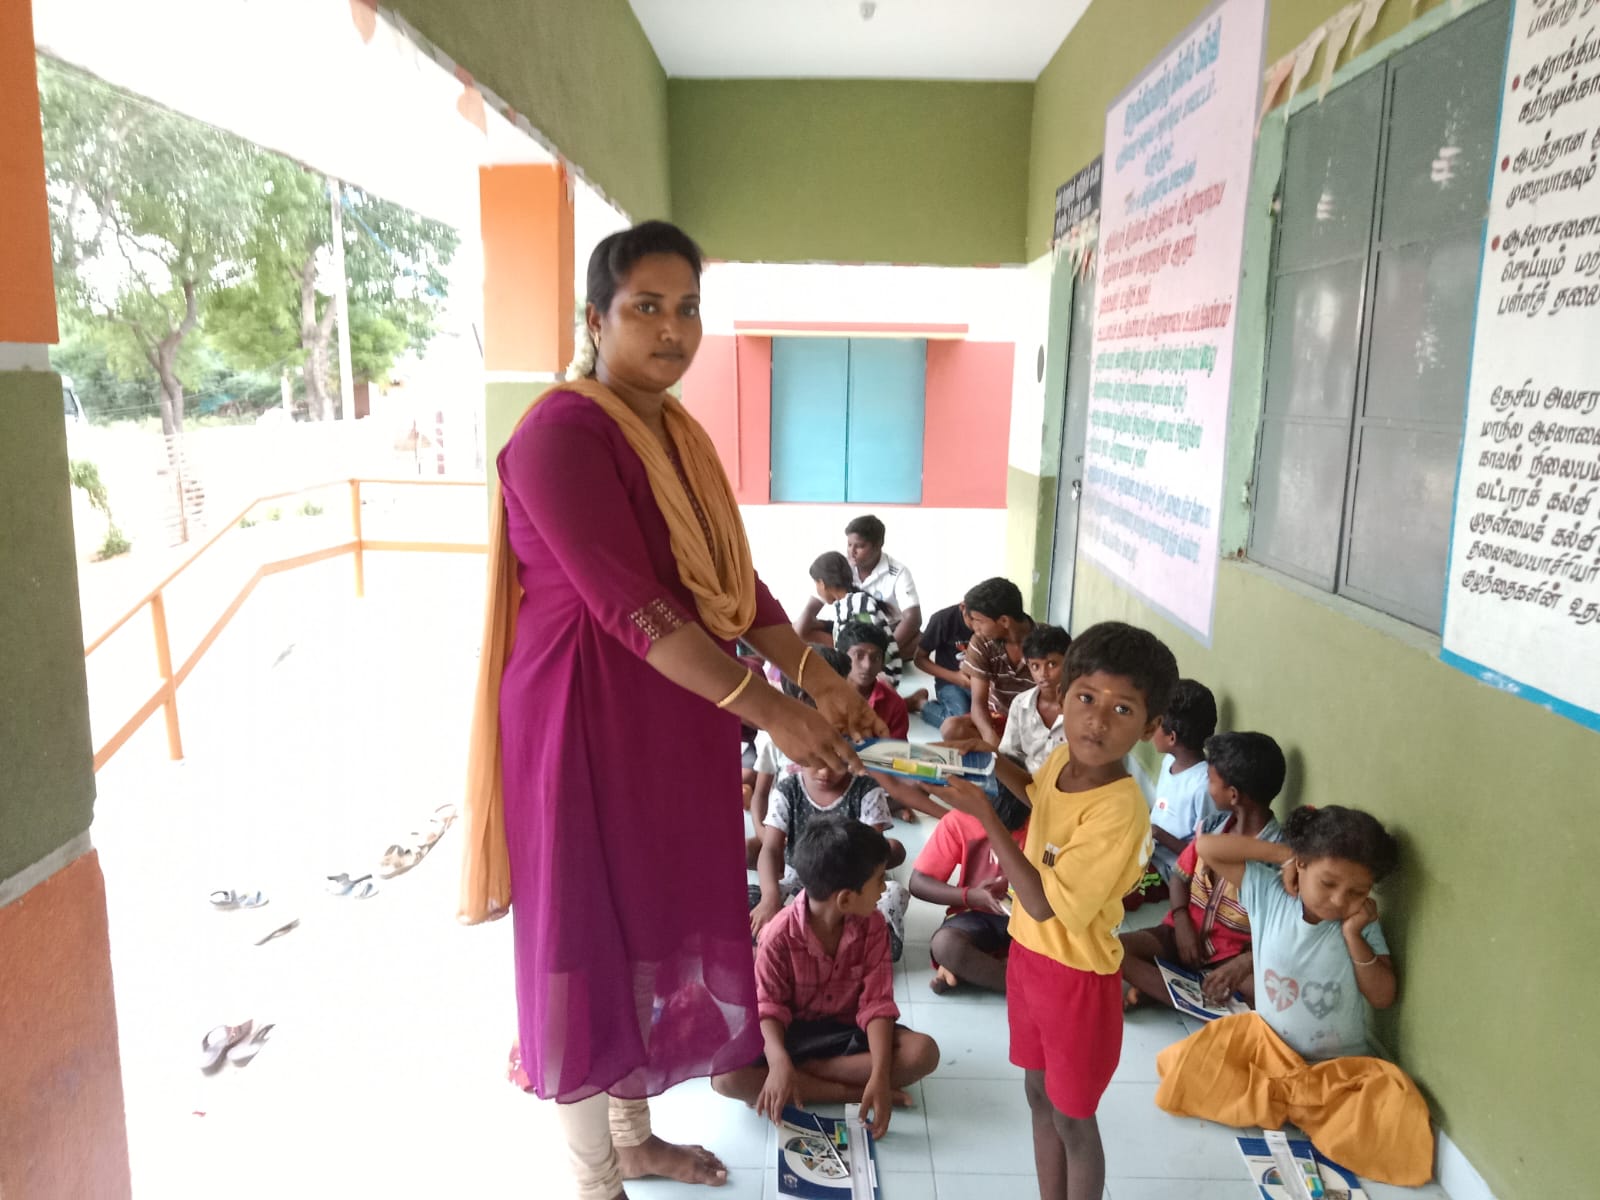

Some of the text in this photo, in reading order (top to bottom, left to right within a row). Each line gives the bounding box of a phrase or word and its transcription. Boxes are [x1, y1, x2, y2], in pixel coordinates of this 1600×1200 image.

[1523, 24, 1600, 90] ஆரோக்கிய
[1518, 72, 1600, 125] கற்றலுக்கா
[1512, 127, 1588, 174] ஆபத்தான
[1505, 153, 1598, 209] முறையாகவும்
[1502, 215, 1600, 257] ஆலோசனை
[1501, 244, 1566, 283] செய்யும்
[1497, 280, 1600, 318] பள்ளித் தலை
[1490, 377, 1541, 413] தேசிய
[1480, 410, 1524, 443] மாநில
[1478, 442, 1523, 471] காவல்
[1476, 477, 1599, 516] வட்டாரக் கல்வி
[1461, 565, 1600, 625] குழந்தைகளின் உத
